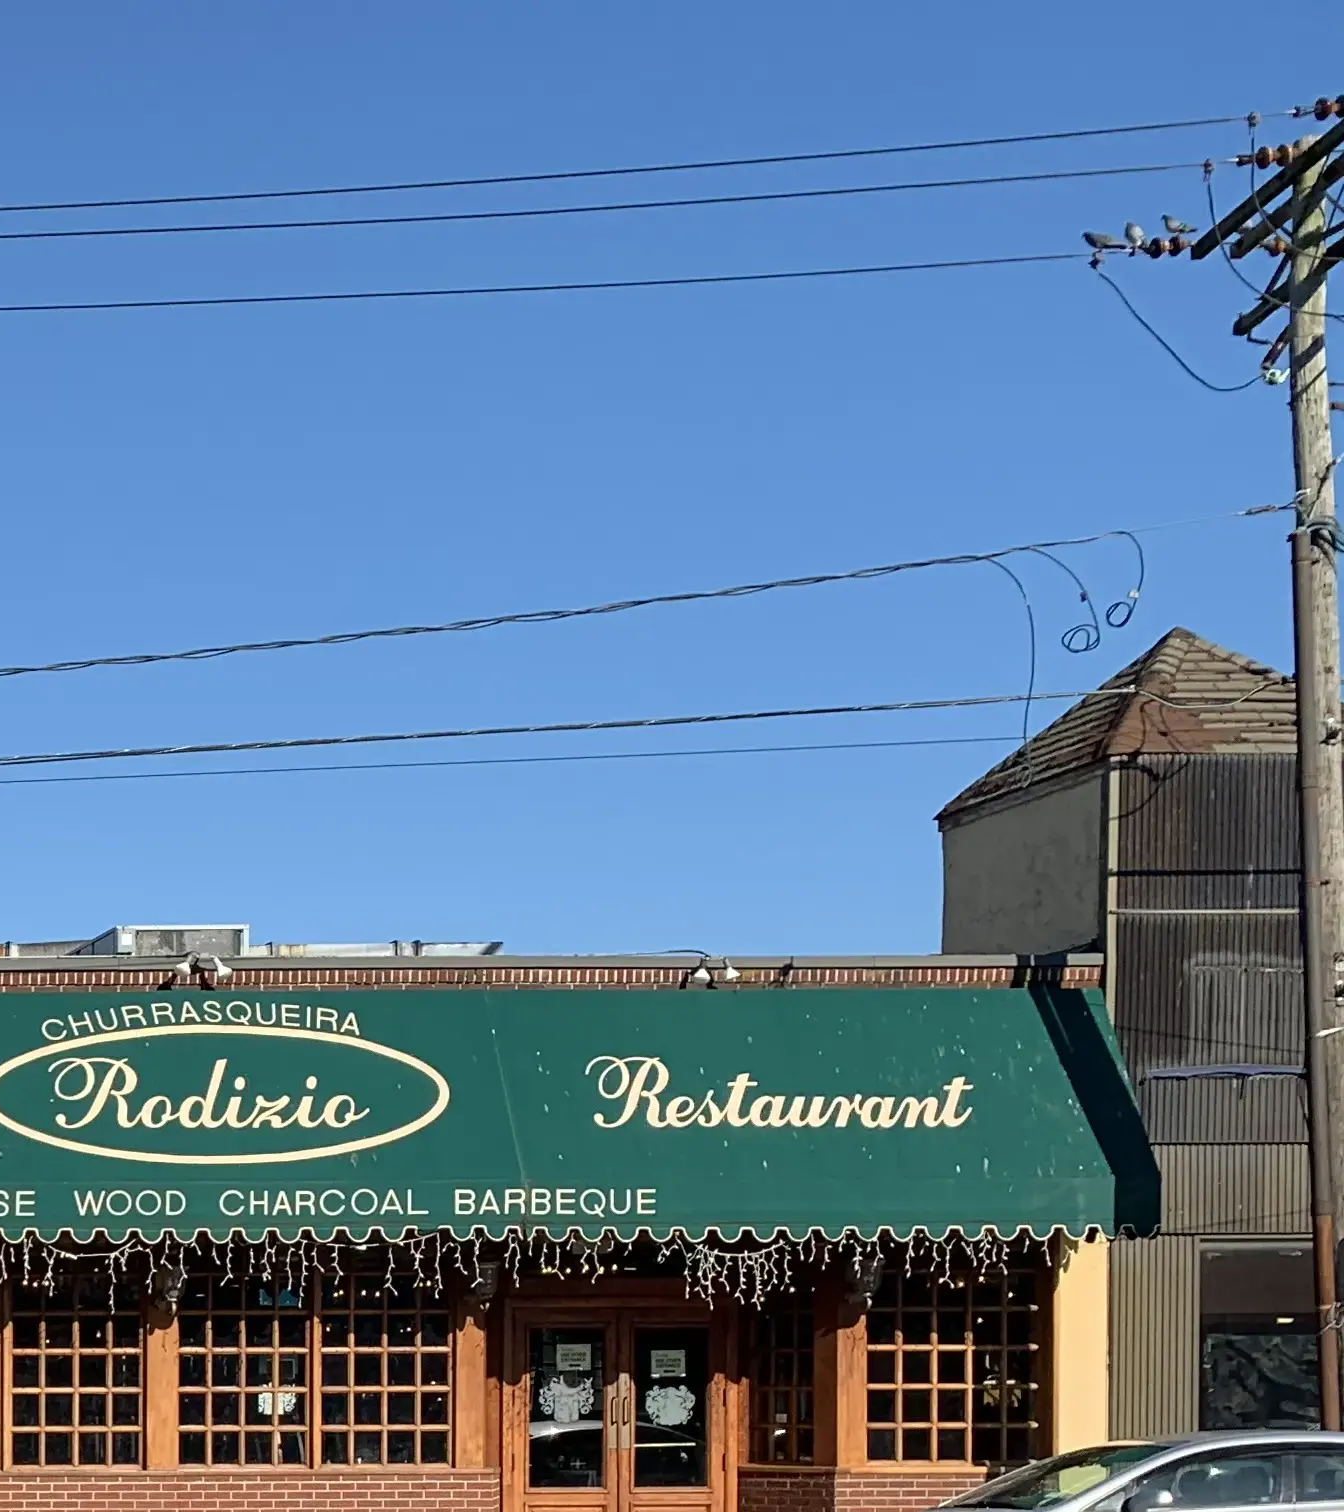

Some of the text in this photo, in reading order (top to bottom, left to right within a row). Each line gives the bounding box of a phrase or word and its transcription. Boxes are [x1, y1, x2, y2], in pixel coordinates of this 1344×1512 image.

[41, 1000, 361, 1043] CHURRASQUEIRA
[48, 1056, 370, 1129] Rodizio
[584, 1055, 974, 1129] Restaurant
[74, 1190, 187, 1217] WOOD
[219, 1189, 429, 1216] CHARCOAL
[453, 1188, 656, 1216] BARBEQUE
